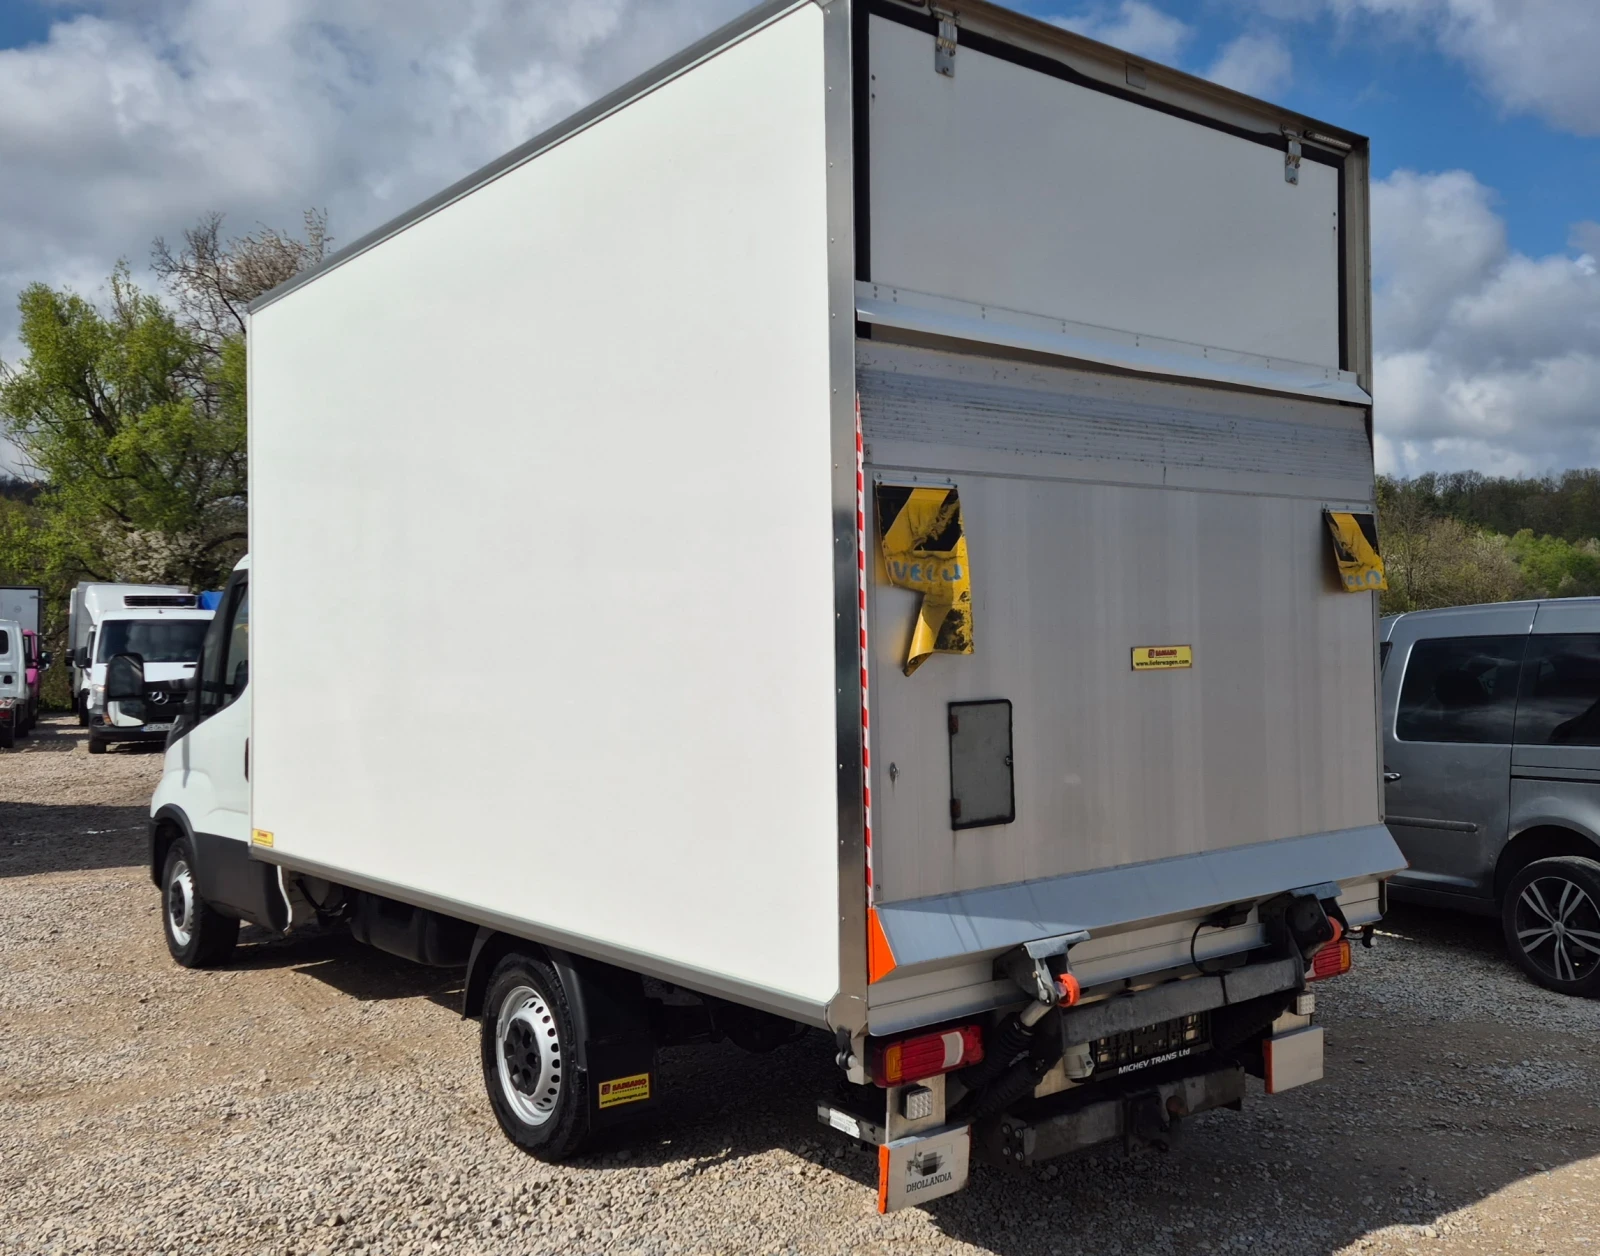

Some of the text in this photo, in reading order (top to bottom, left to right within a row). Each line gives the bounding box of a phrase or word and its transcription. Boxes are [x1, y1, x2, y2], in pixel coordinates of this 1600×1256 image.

[1118, 1048, 1191, 1075] MICHEV TRANS Ltd
[906, 1172, 952, 1193] DHOLLANDIA
